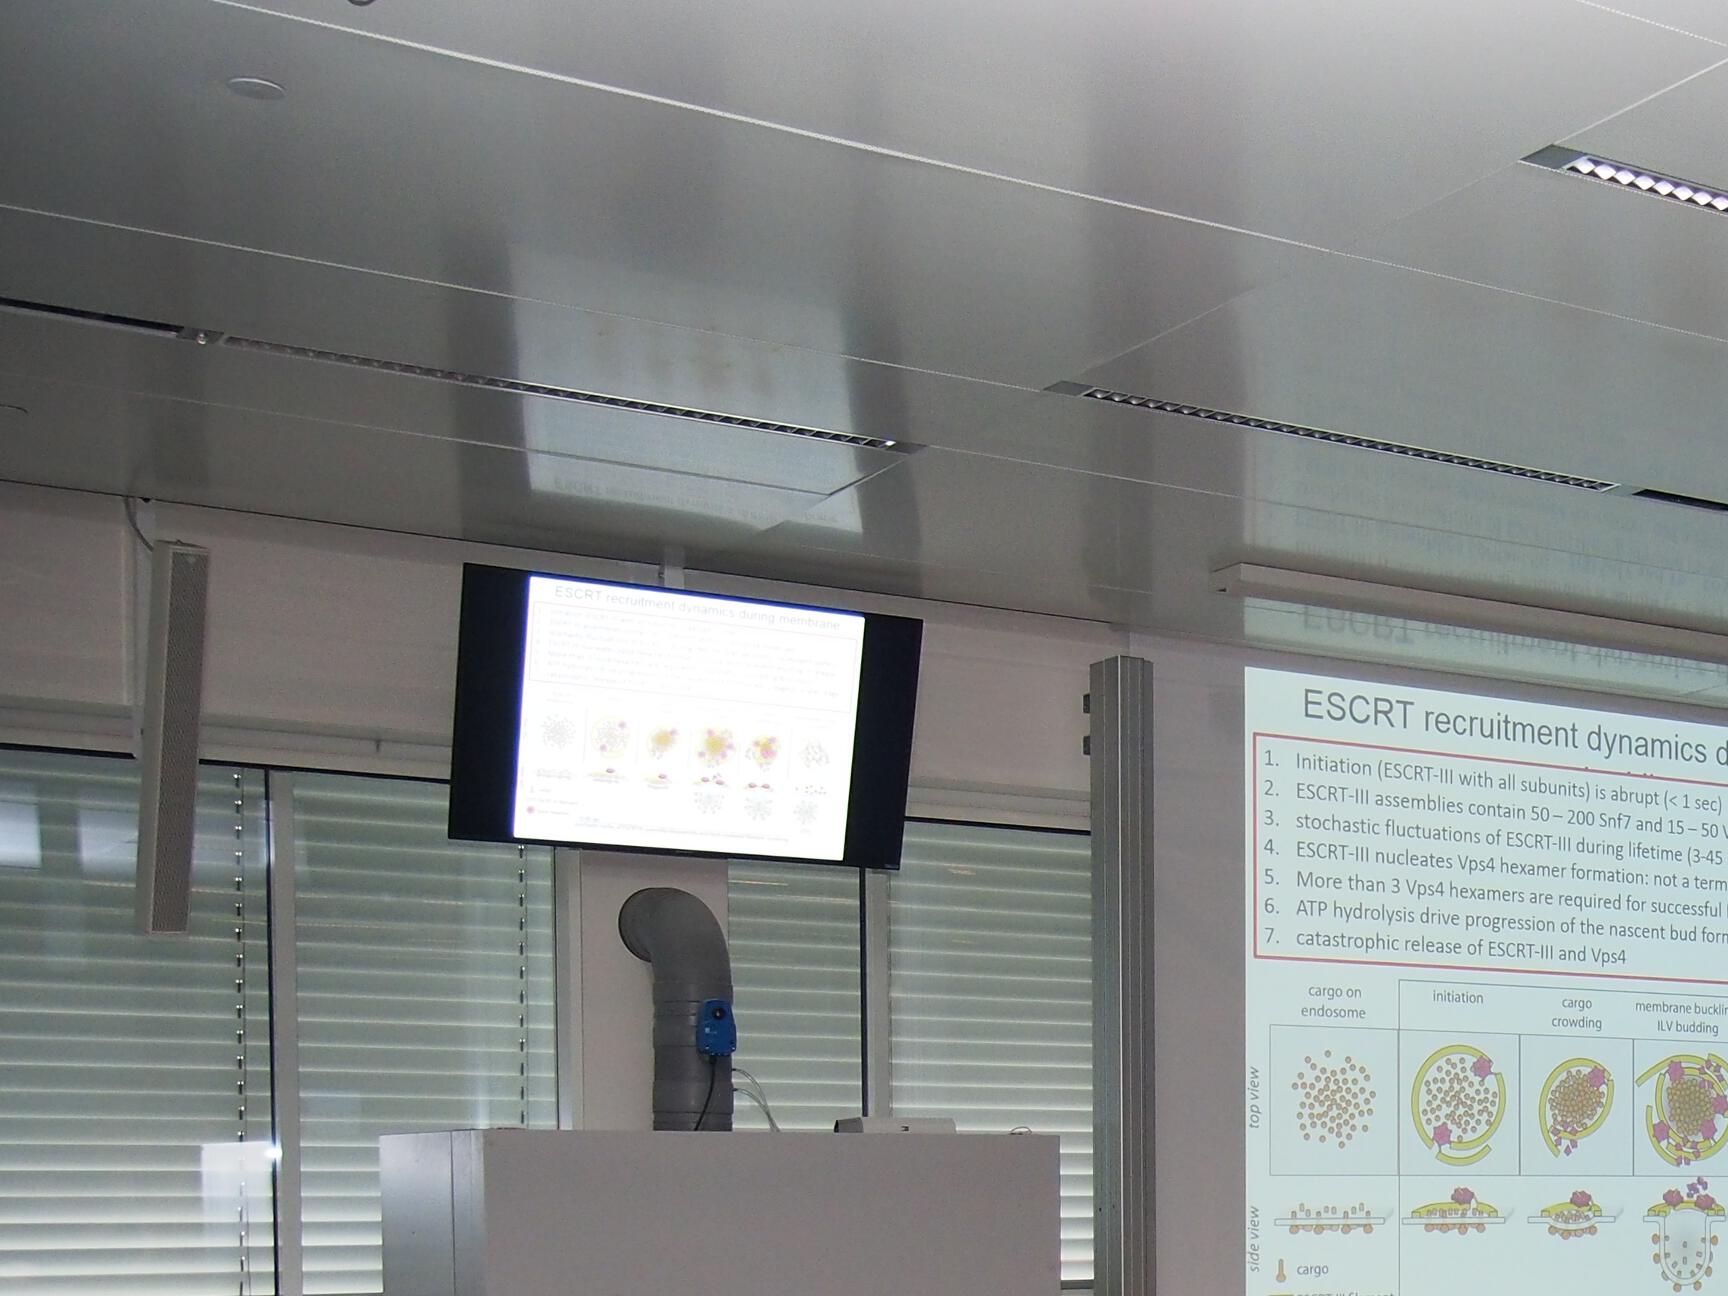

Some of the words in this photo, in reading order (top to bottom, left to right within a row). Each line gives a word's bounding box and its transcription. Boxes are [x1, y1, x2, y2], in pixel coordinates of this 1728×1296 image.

[1304, 688, 1414, 729] ESCRT
[1424, 710, 1578, 749] recruitment
[1586, 724, 1707, 763] dynamics
[1264, 749, 1279, 767] 1.
[1296, 752, 1372, 776] Initiation
[1377, 759, 1453, 785] (ESCRT-III
[1458, 770, 1493, 789] with
[1498, 772, 1515, 791] all
[1520, 776, 1590, 803] subunits)
[1595, 783, 1606, 800] is
[1610, 784, 1660, 809] abrupt
[1682, 793, 1690, 809] 1
[1694, 795, 1722, 816] sec)
[1264, 779, 1279, 796] 2.
[1296, 782, 1368, 805] ESCRT-III
[1374, 793, 1463, 814] assemblies
[1468, 802, 1526, 820] contain
[1530, 805, 1550, 822] 50
[1567, 809, 1595, 826] 200
[1598, 812, 1631, 830] Snf7
[1636, 816, 1662, 833] and
[1667, 819, 1684, 835] 15
[1701, 822, 1718, 838] 50
[1263, 809, 1279, 827] 3.
[1296, 813, 1380, 835] stochastic
[1384, 818, 1480, 844] fluctuations
[1485, 828, 1502, 846] of
[1506, 831, 1571, 852] ESCRT-III
[1576, 836, 1624, 861] during
[1628, 840, 1682, 862] lifetime
[1687, 846, 1723, 867] (3-45
[1264, 867, 1279, 885] 5.
[1296, 870, 1342, 890] More
[1347, 873, 1385, 893] than
[1391, 877, 1400, 894] 3
[1405, 878, 1445, 900] Vps4
[1449, 879, 1524, 903] hexamers
[1529, 892, 1554, 905] are
[1558, 893, 1621, 912] required
[1625, 894, 1647, 912] for
[1650, 900, 1722, 918] successful
[1264, 927, 1280, 944] 7.
[1296, 931, 1399, 954] catastrophic
[1404, 935, 1462, 954] release
[1466, 938, 1484, 956] of
[1488, 940, 1553, 960] ESCRT-III
[1558, 945, 1586, 962] and
[1590, 947, 1626, 968] Vps4
[1308, 986, 1343, 1001] cargo
[1345, 987, 1362, 998] on
[1432, 989, 1484, 1004] initiation
[1561, 998, 1592, 1012] cargo
[1635, 1000, 1692, 1014] membrane
[1300, 1003, 1366, 1019] endosome
[1551, 1015, 1602, 1032] crowding
[1657, 1019, 1674, 1032] ILV
[1675, 1019, 1719, 1037] budding
[1247, 1066, 1260, 1100] view
[1249, 1104, 1262, 1129] top
[1247, 1206, 1260, 1239] view
[1247, 1243, 1260, 1272] side
[1296, 1264, 1329, 1278] cargo
